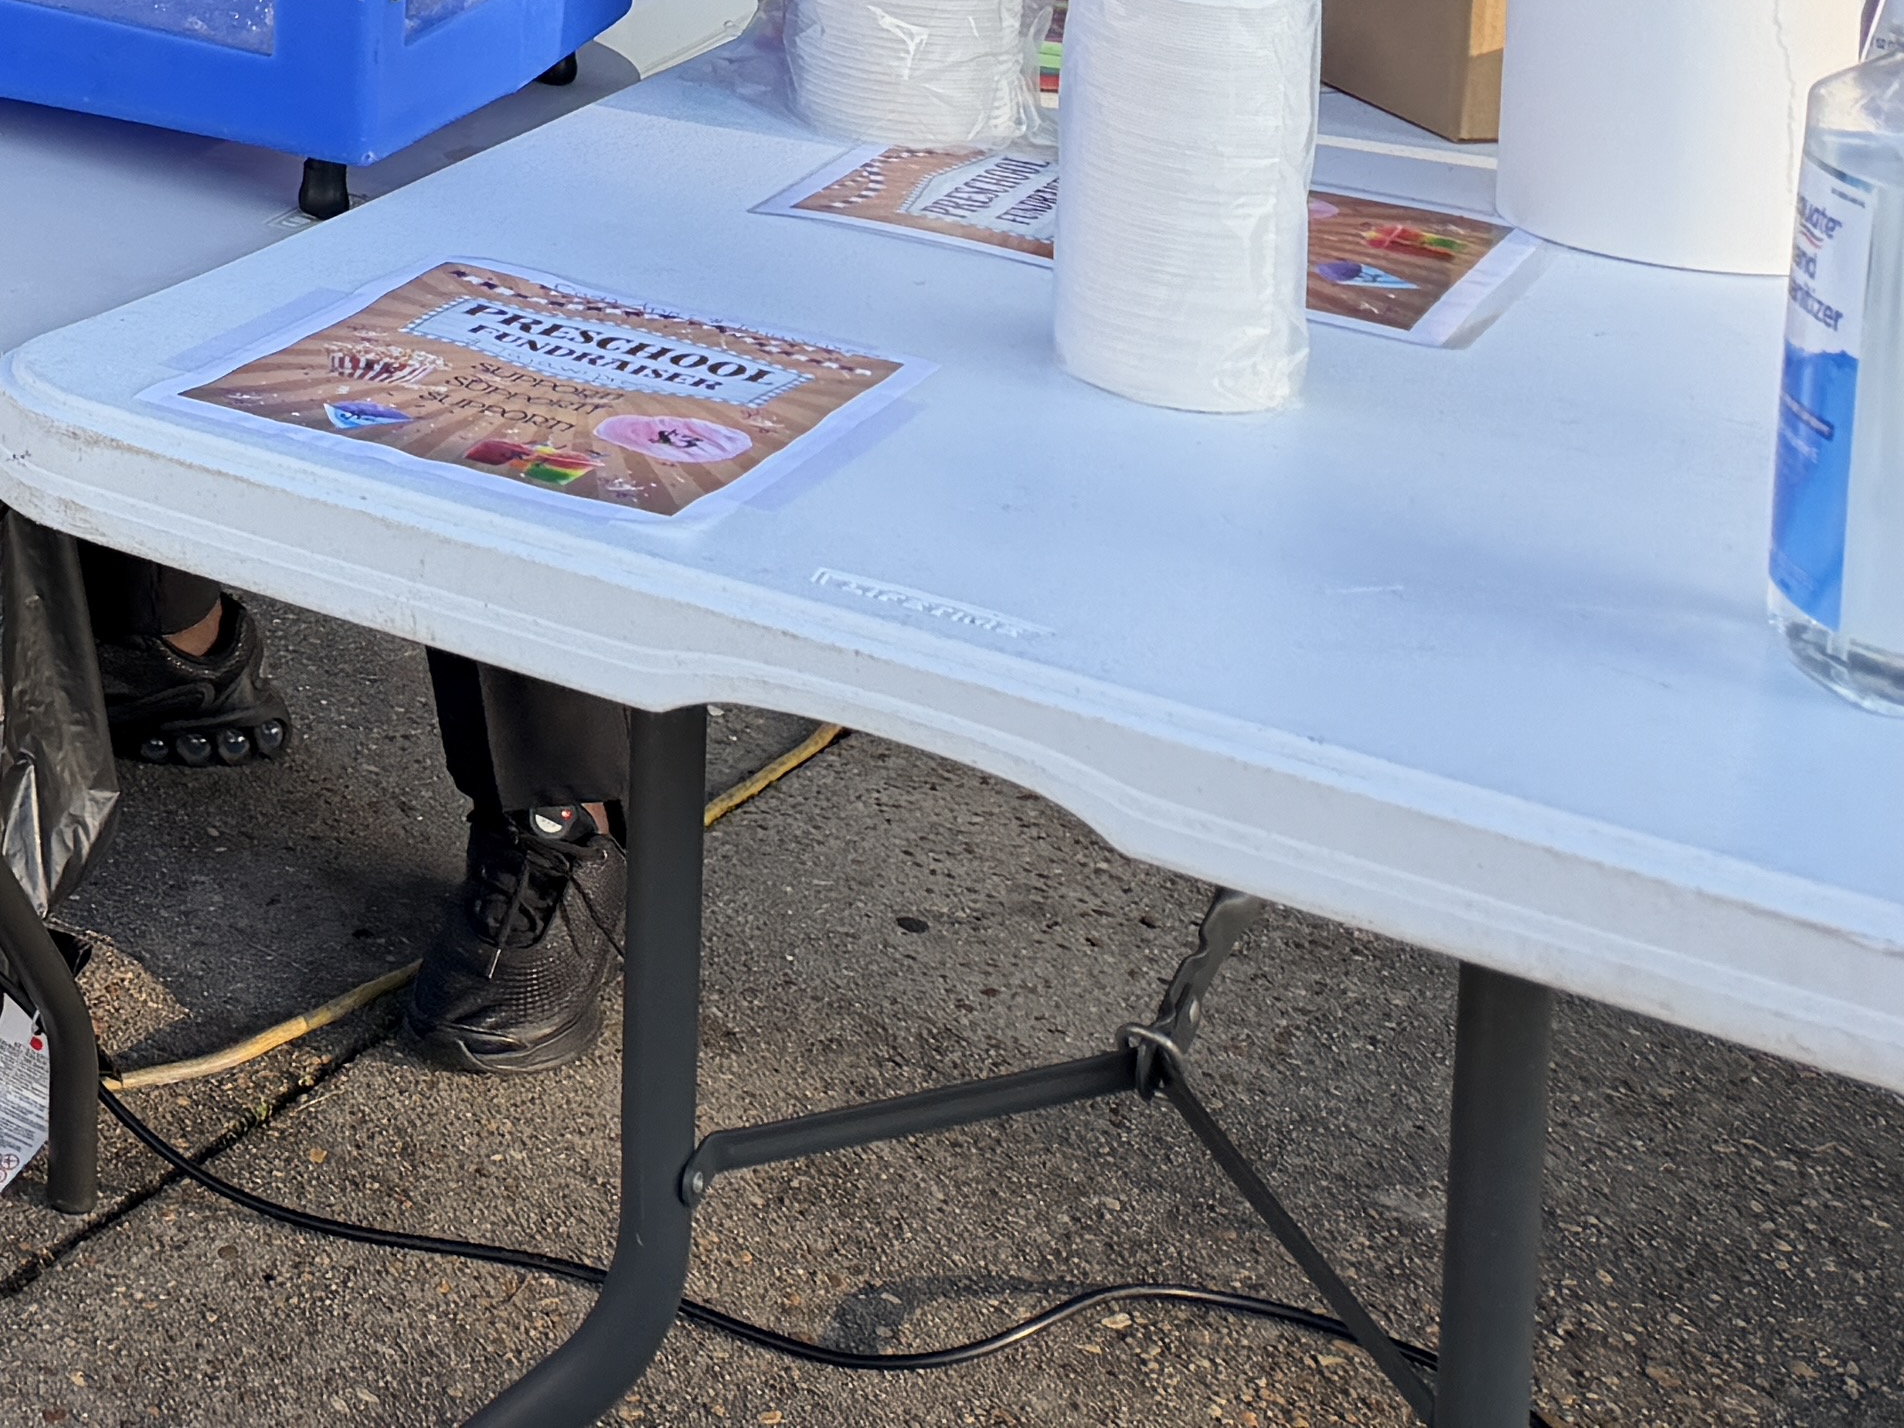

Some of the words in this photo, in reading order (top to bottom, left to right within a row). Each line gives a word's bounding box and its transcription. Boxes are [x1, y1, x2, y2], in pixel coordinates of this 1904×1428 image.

[919, 156, 1052, 218] PRESCHOOL
[463, 302, 774, 386] PRESCHOOL
[468, 324, 723, 391] FUNDRAISER
